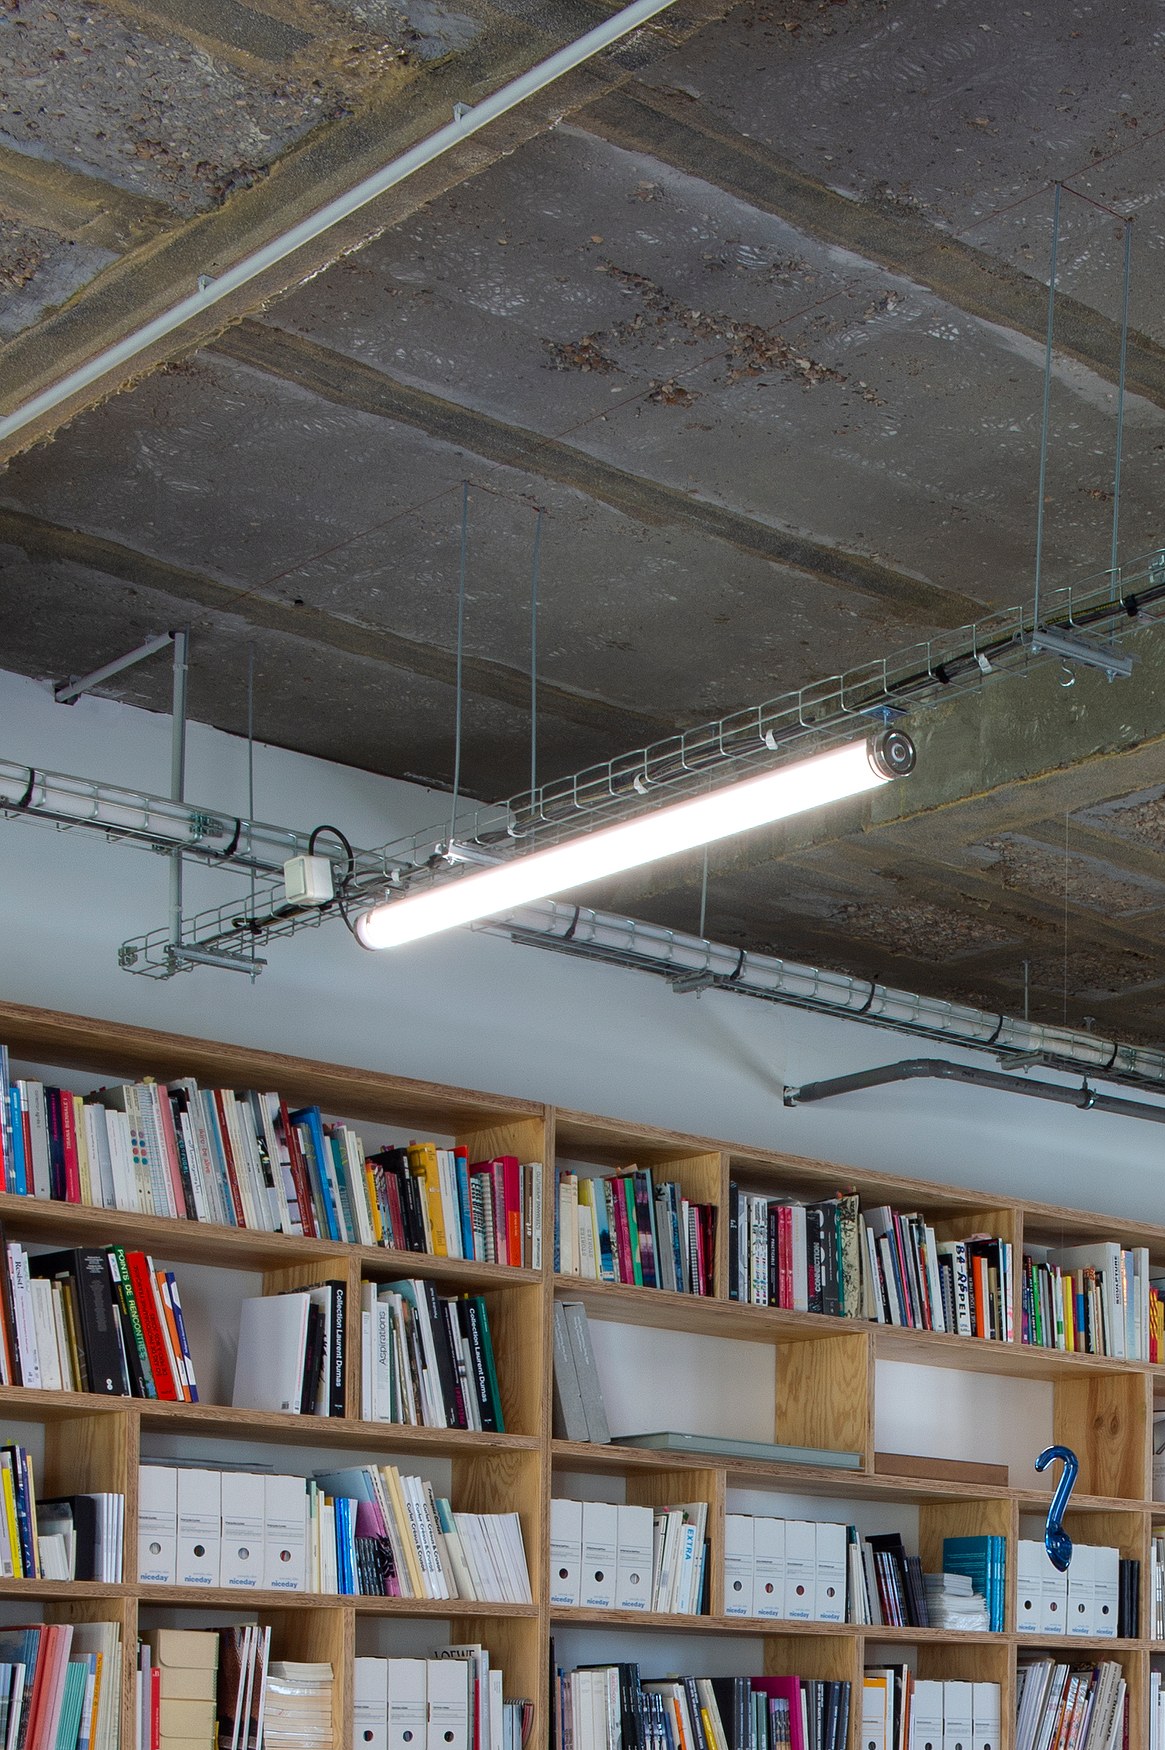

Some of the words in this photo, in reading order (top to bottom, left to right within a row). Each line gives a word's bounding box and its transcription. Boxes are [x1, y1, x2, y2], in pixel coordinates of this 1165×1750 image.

[62, 1101, 70, 1128] BIENNALE
[14, 1261, 24, 1288] Resist!
[115, 1248, 129, 1281] POINTS
[812, 1241, 821, 1291] CONNECTION
[124, 1284, 132, 1296] DE
[335, 1289, 343, 1328] Collection
[127, 1300, 148, 1359] RENCONTRES
[138, 1298, 155, 1344] PHOTOGRAPHIE
[468, 1307, 480, 1346] Collection
[377, 1311, 387, 1365] Aspirations
[474, 1346, 484, 1375] Laurent
[478, 1376, 488, 1402] Dumas
[405, 1502, 414, 1521] Curlet
[414, 1502, 423, 1521] Curlet
[422, 1502, 430, 1521] Curlet
[683, 1528, 695, 1560] EXTRA
[141, 1573, 168, 1582] niceday
[185, 1575, 212, 1584] niceday
[229, 1578, 256, 1586] niceday
[272, 1580, 297, 1588] niceday
[551, 1596, 573, 1604] niceday
[587, 1598, 609, 1606] niceday
[622, 1600, 645, 1608] niceday
[758, 1609, 778, 1617] niceday
